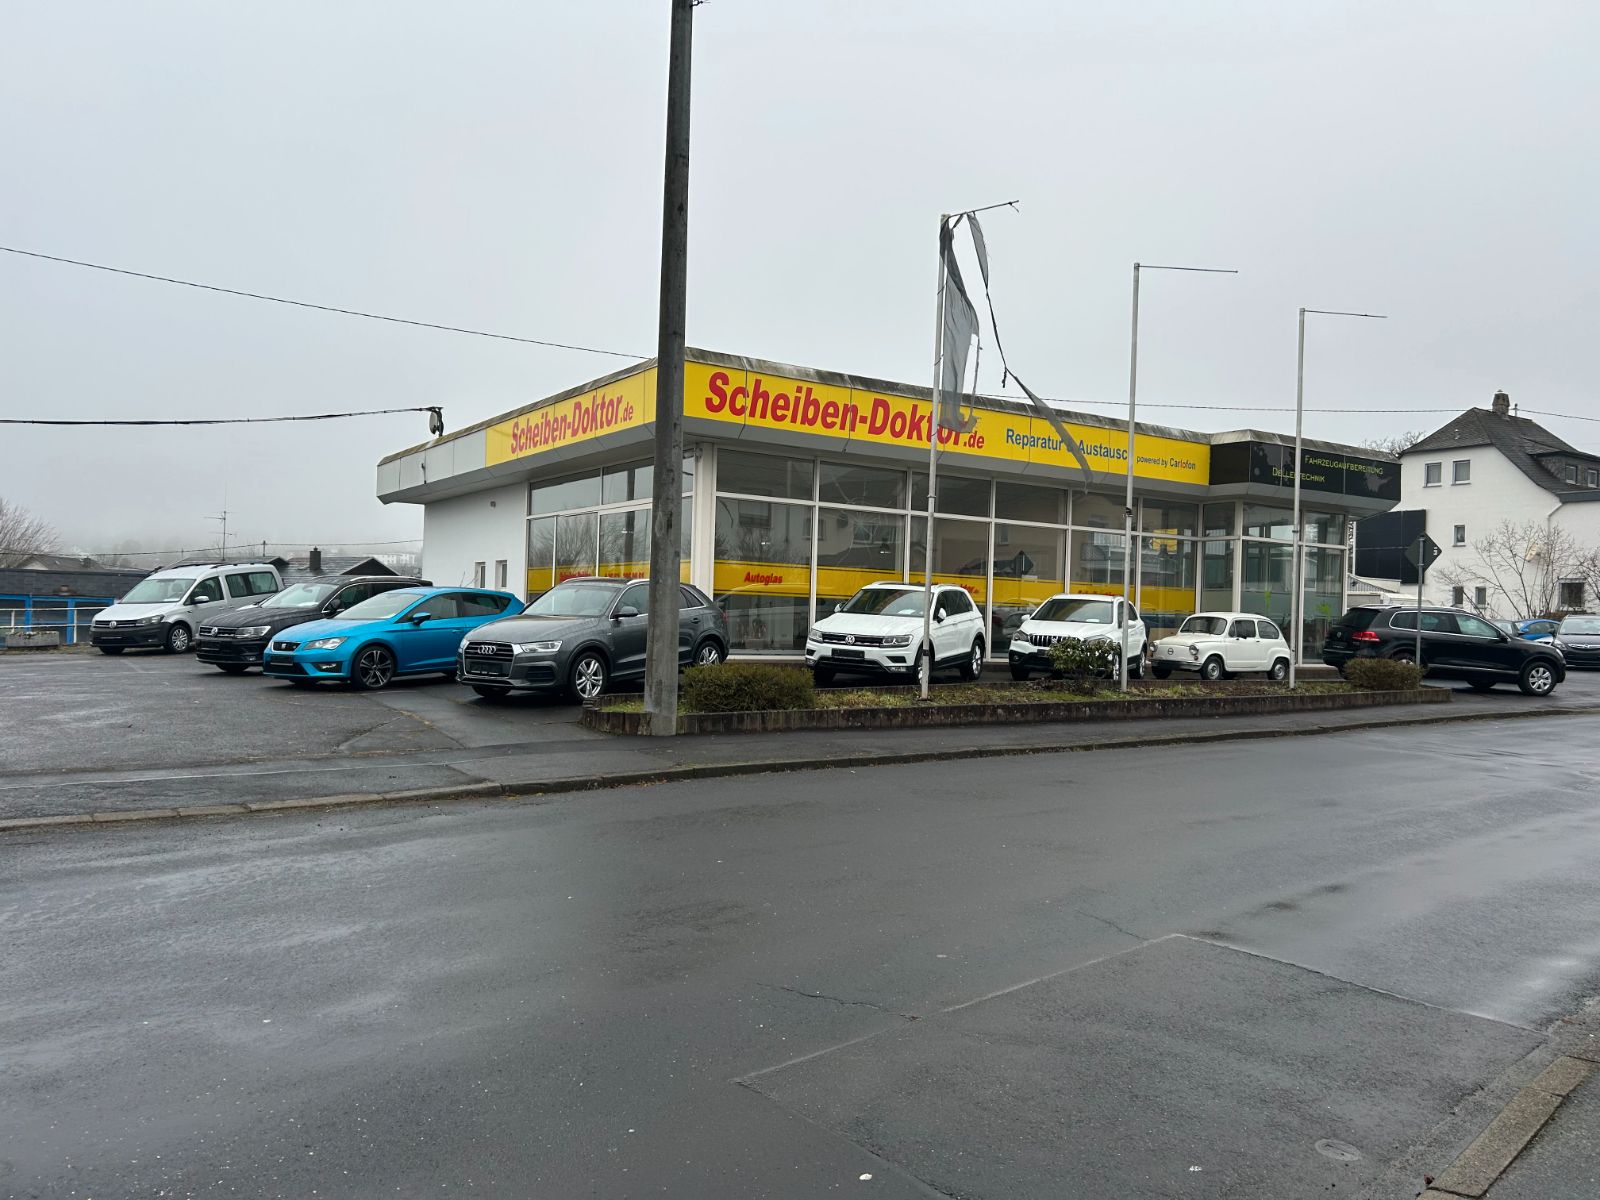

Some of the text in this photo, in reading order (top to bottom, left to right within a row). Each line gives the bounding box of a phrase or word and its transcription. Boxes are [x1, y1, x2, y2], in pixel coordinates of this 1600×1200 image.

[511, 393, 634, 454] Scheiben-Doktor.de
[1006, 428, 1064, 451] Reparatur
[1079, 439, 1132, 461] Austausc
[1136, 455, 1161, 465] powered
[1161, 457, 1168, 468] by
[1272, 466, 1326, 482] DELLETECHNIK
[744, 571, 783, 586] Autoglas
